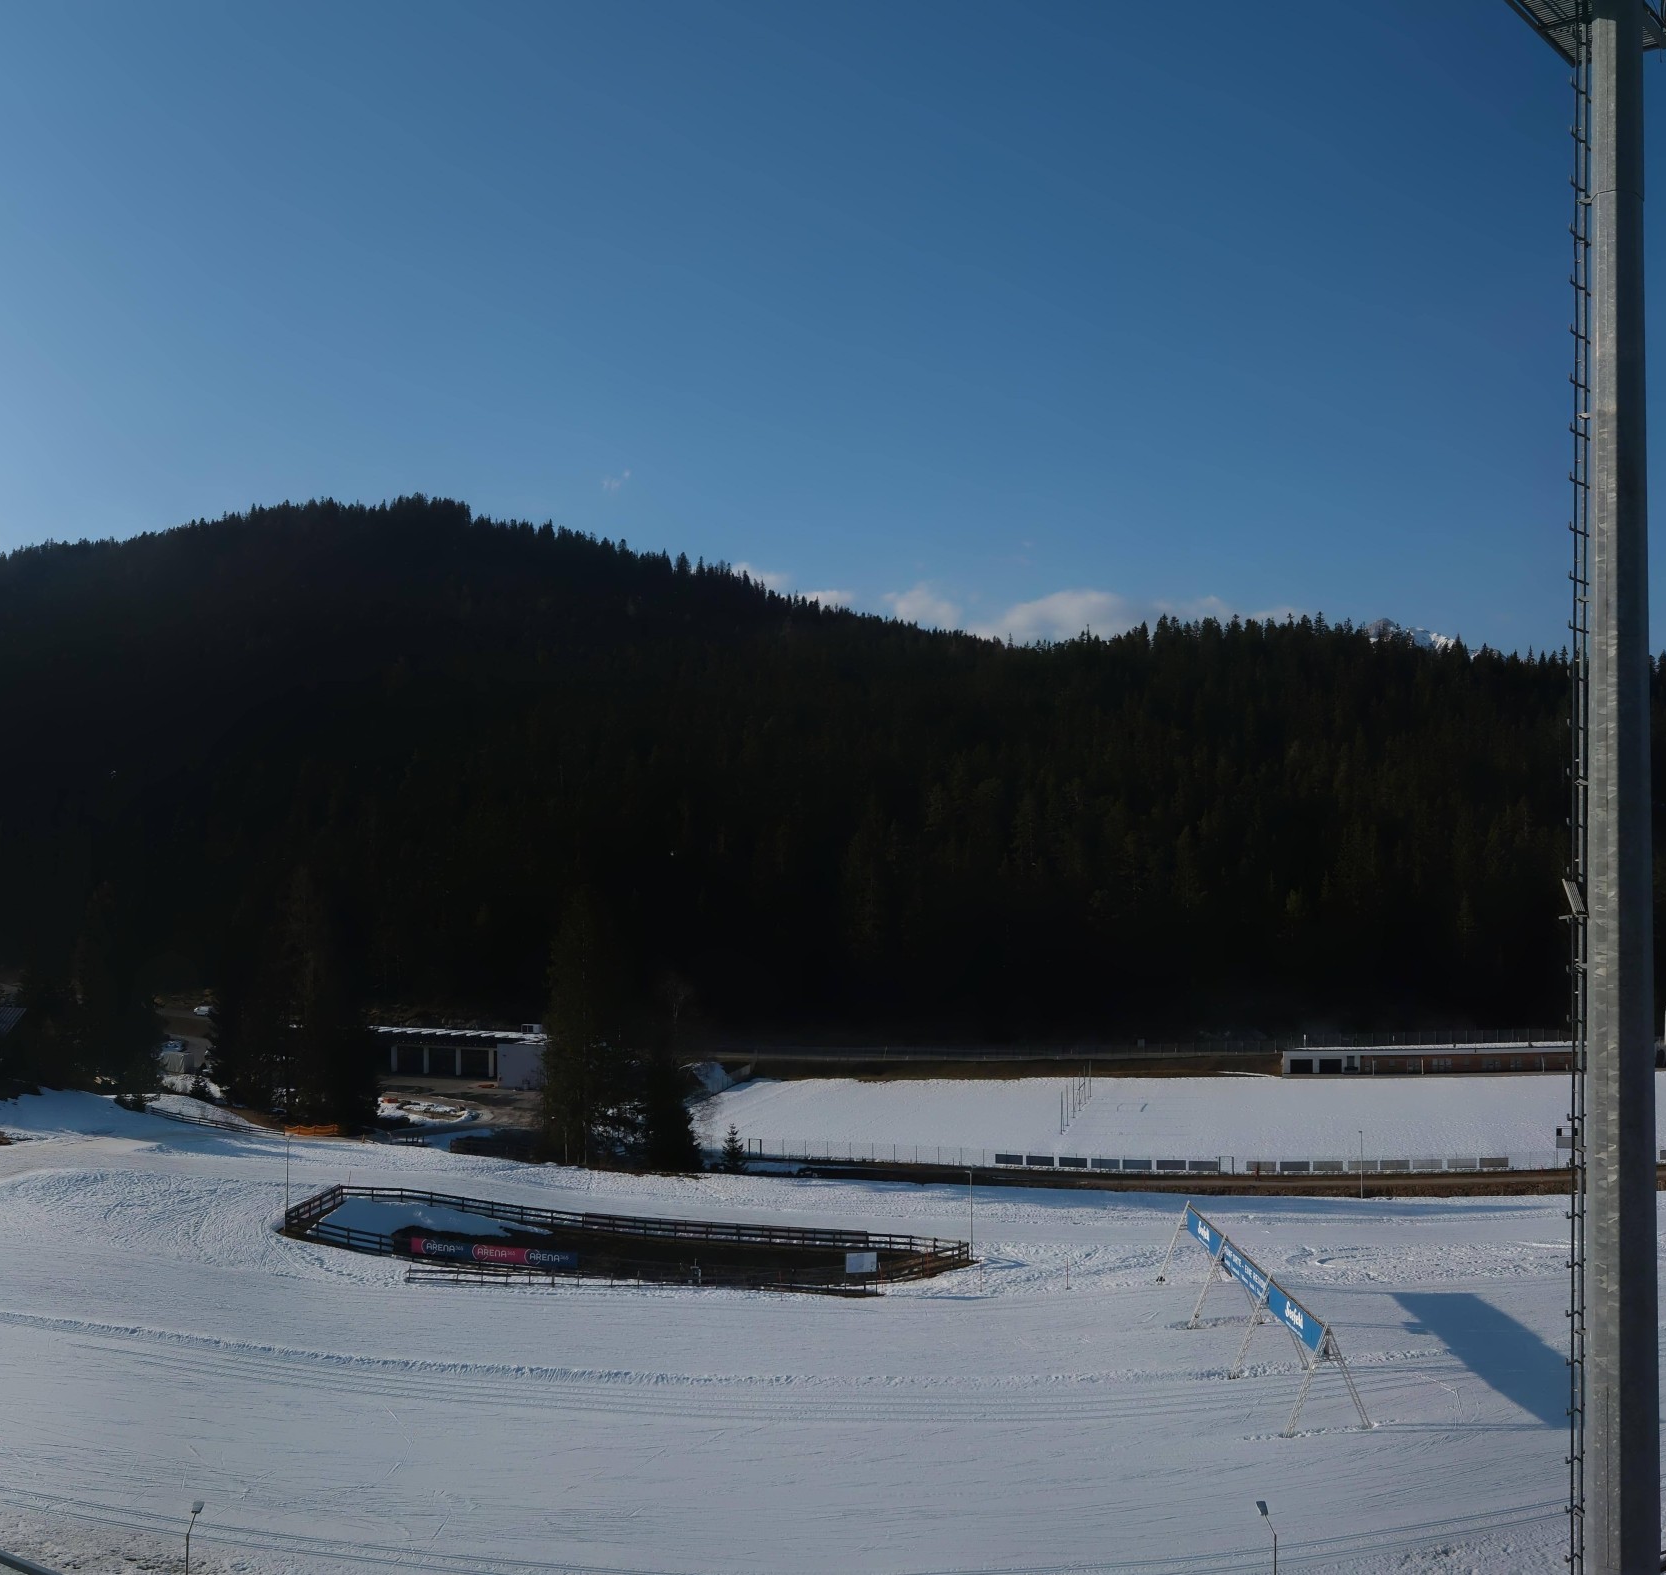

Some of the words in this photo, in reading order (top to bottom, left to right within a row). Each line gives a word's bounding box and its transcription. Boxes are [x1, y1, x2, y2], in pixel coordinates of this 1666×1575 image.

[426, 1242, 455, 1253] ARENA
[477, 1248, 507, 1258] ARENA
[529, 1252, 560, 1262] ARENA
